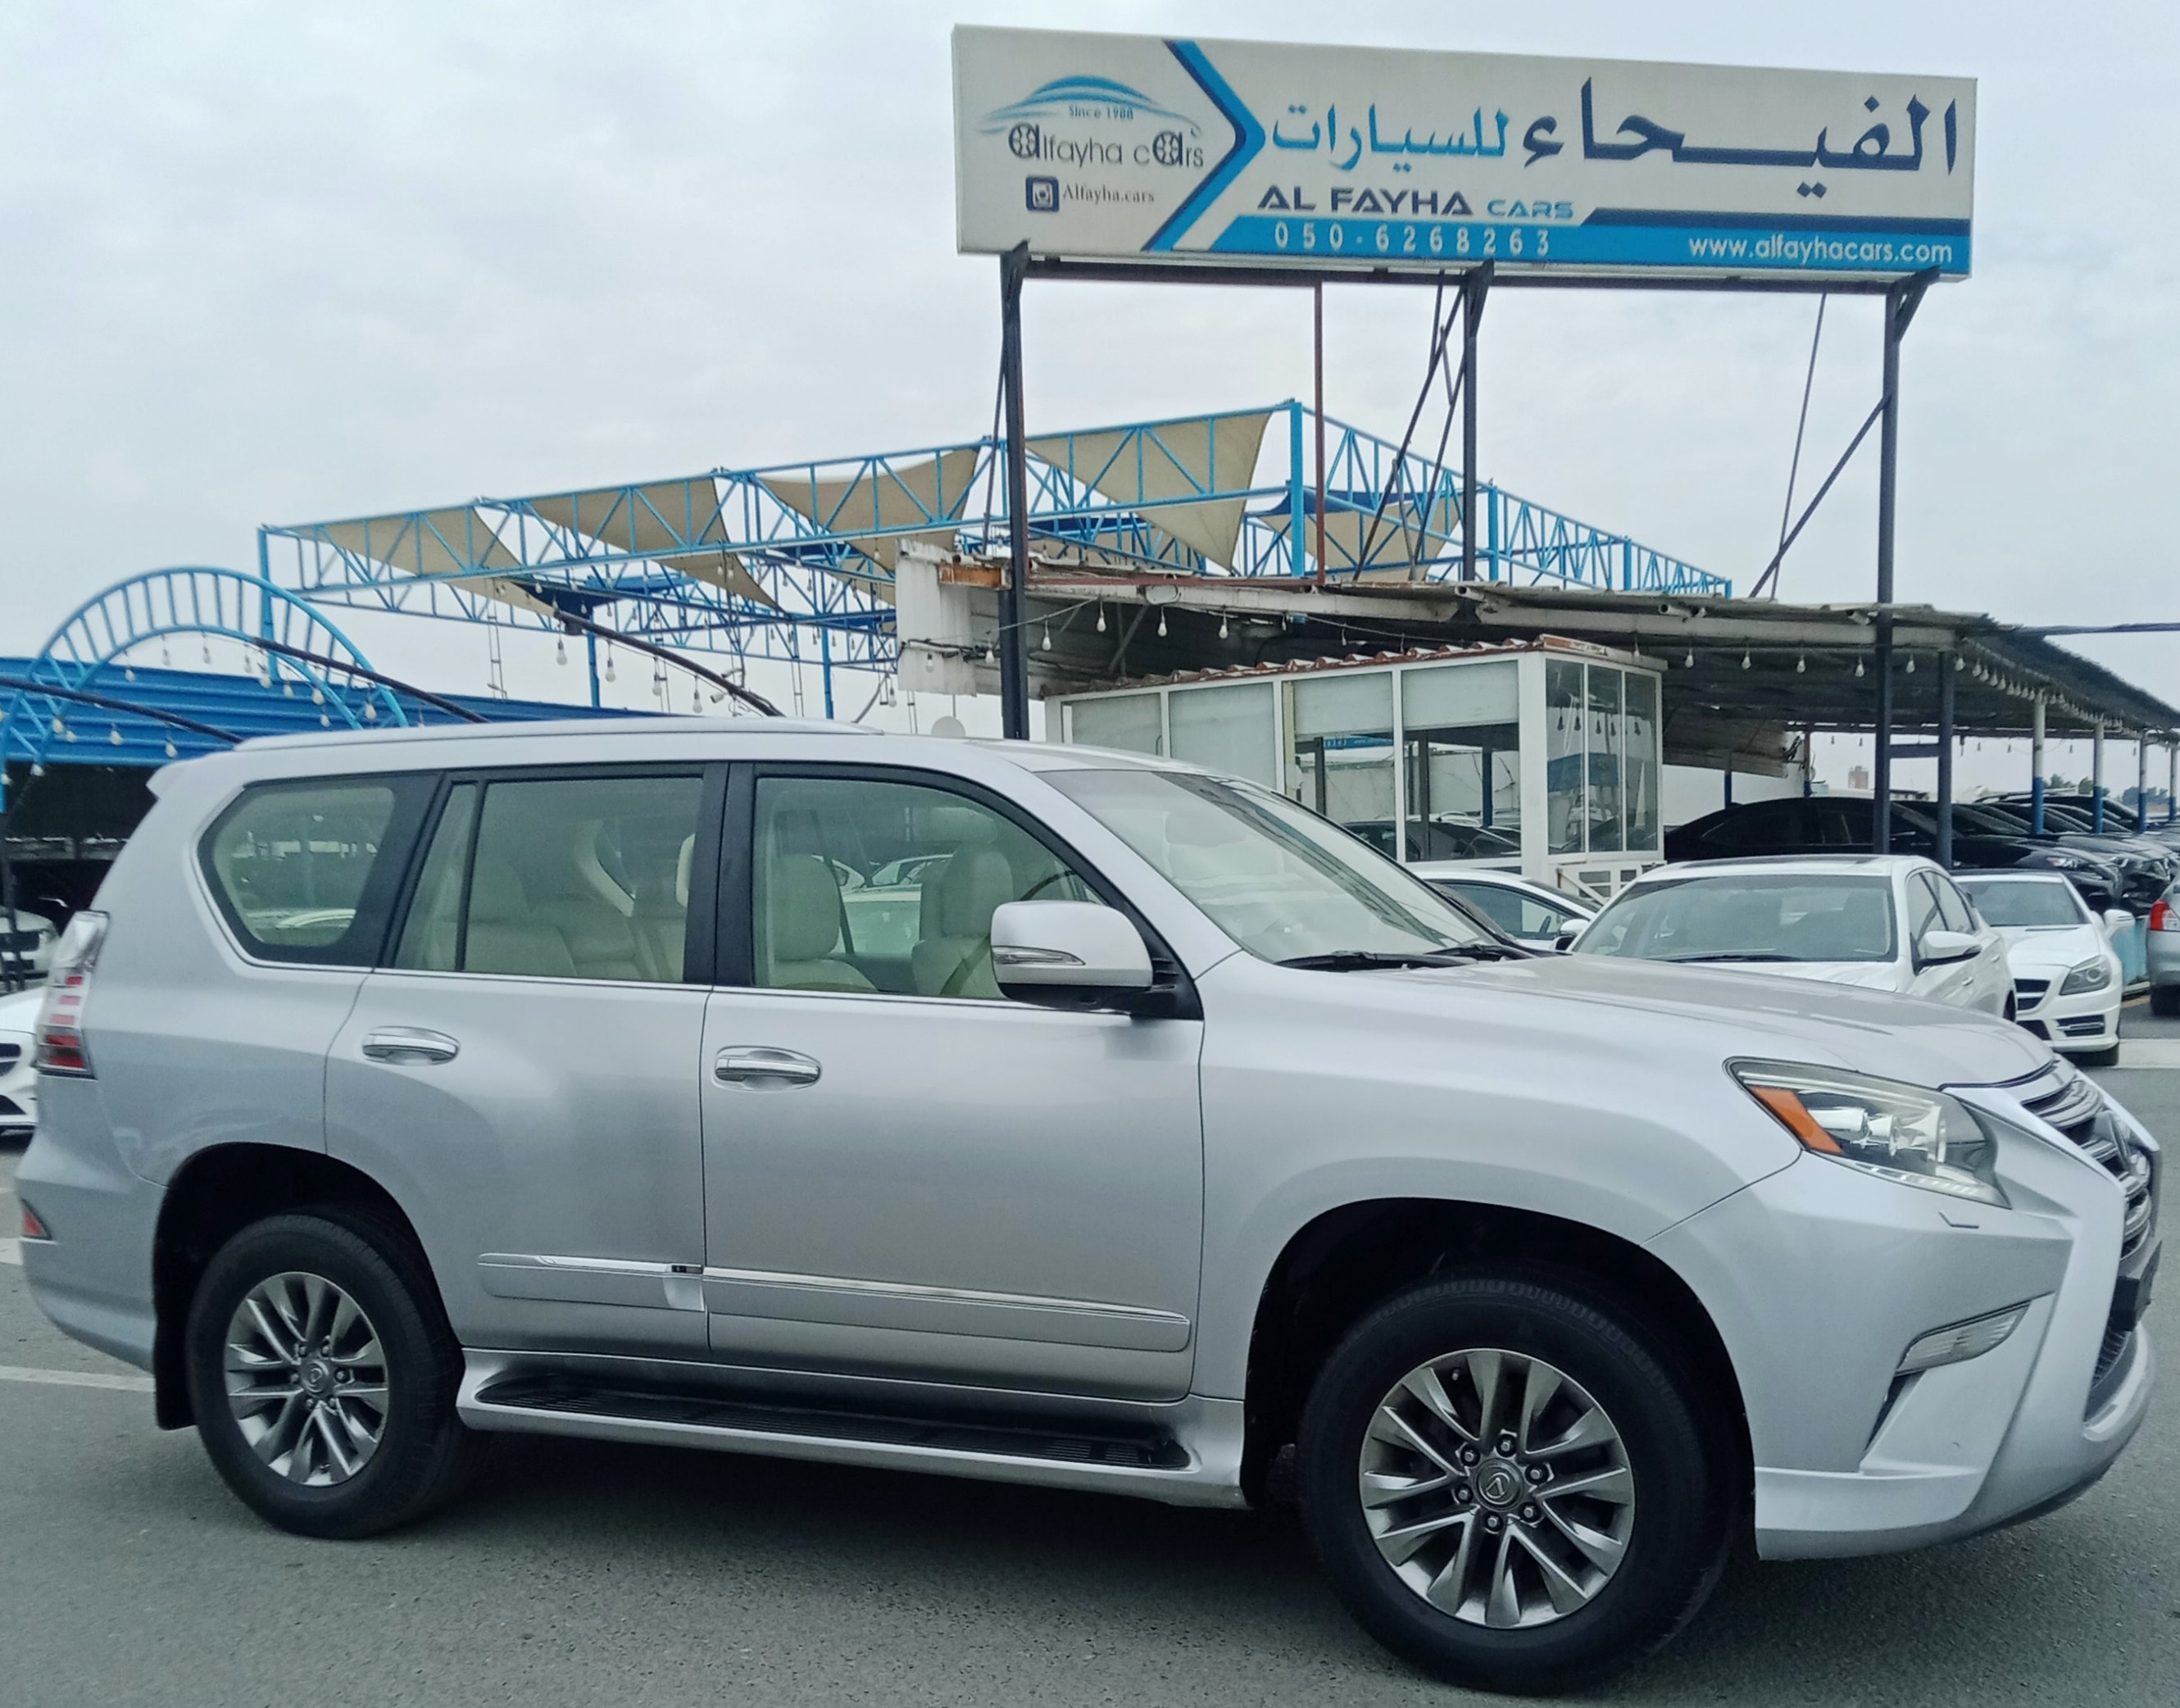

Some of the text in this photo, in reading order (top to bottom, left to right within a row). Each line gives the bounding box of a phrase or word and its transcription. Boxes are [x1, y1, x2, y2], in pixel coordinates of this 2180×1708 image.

[1069, 104, 1101, 119] Since
[1008, 123, 1204, 167] alfayha cars
[1272, 75, 1957, 199] الفيحاء للسيارات
[1063, 184, 1155, 203] Alfayha.cars
[1257, 184, 1574, 219] AL FAYHA CARS
[1689, 234, 1953, 264] www.alfayhacars.com
